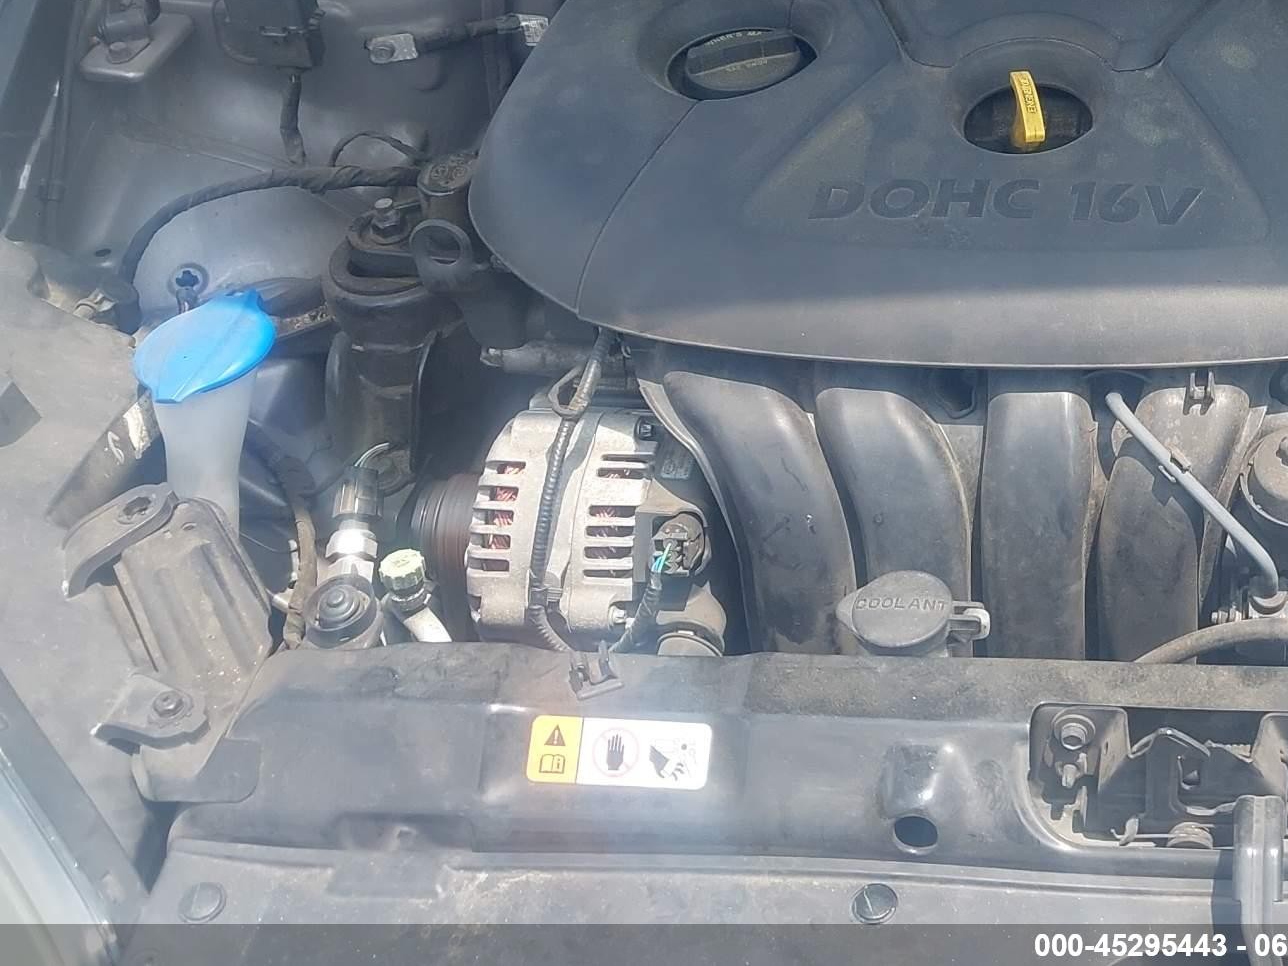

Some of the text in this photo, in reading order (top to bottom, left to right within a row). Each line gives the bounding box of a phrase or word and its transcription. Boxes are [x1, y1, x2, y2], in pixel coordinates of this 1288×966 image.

[808, 178, 1204, 225] DOHC 16V
[855, 596, 947, 612] COOLANT
